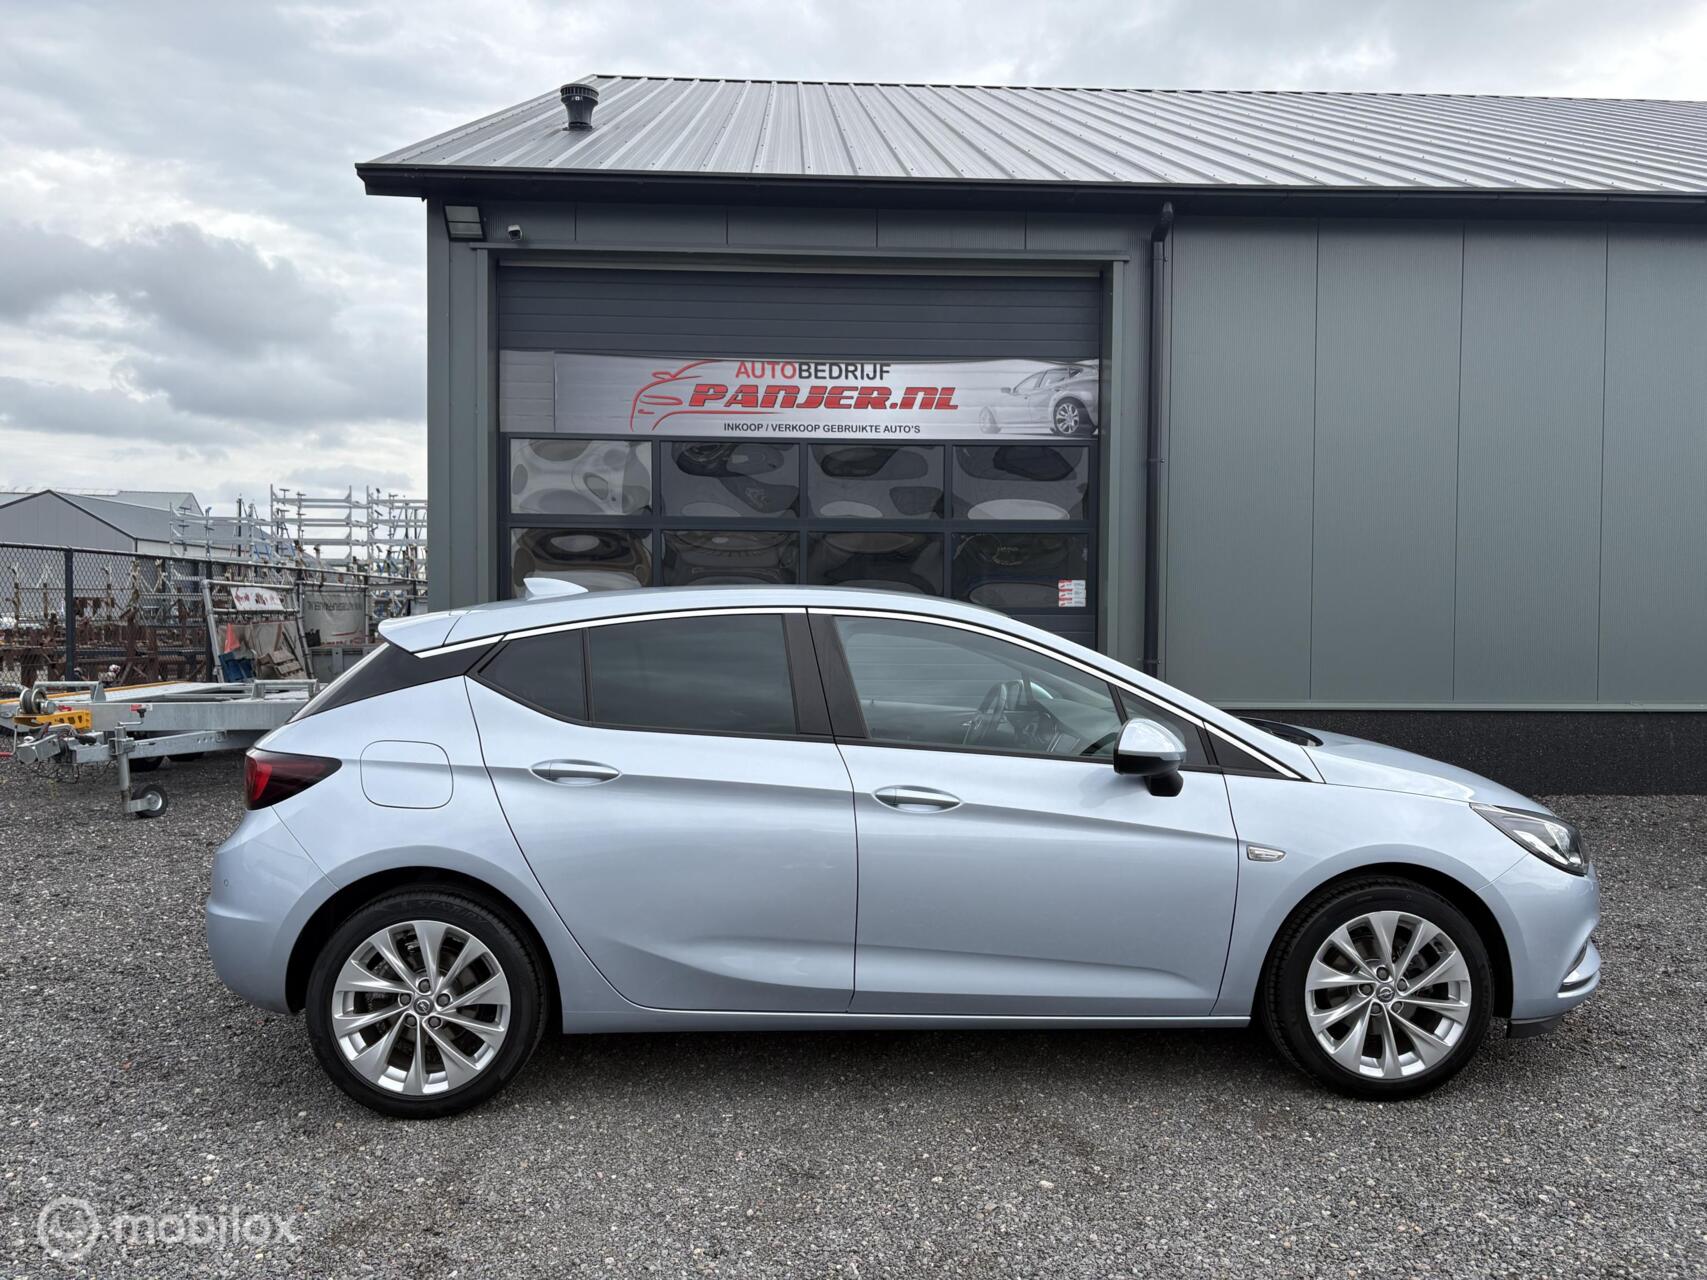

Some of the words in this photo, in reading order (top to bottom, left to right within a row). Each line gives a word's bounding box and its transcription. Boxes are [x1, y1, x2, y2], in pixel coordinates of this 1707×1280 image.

[735, 361, 892, 381] AUTOBEDRIJF
[688, 383, 959, 410] PANJER.NL
[723, 423, 763, 432] INKOOP
[771, 424, 820, 433] VERKOOP
[823, 424, 881, 433] GEBRUIKTE
[883, 425, 921, 433] AUTO'S
